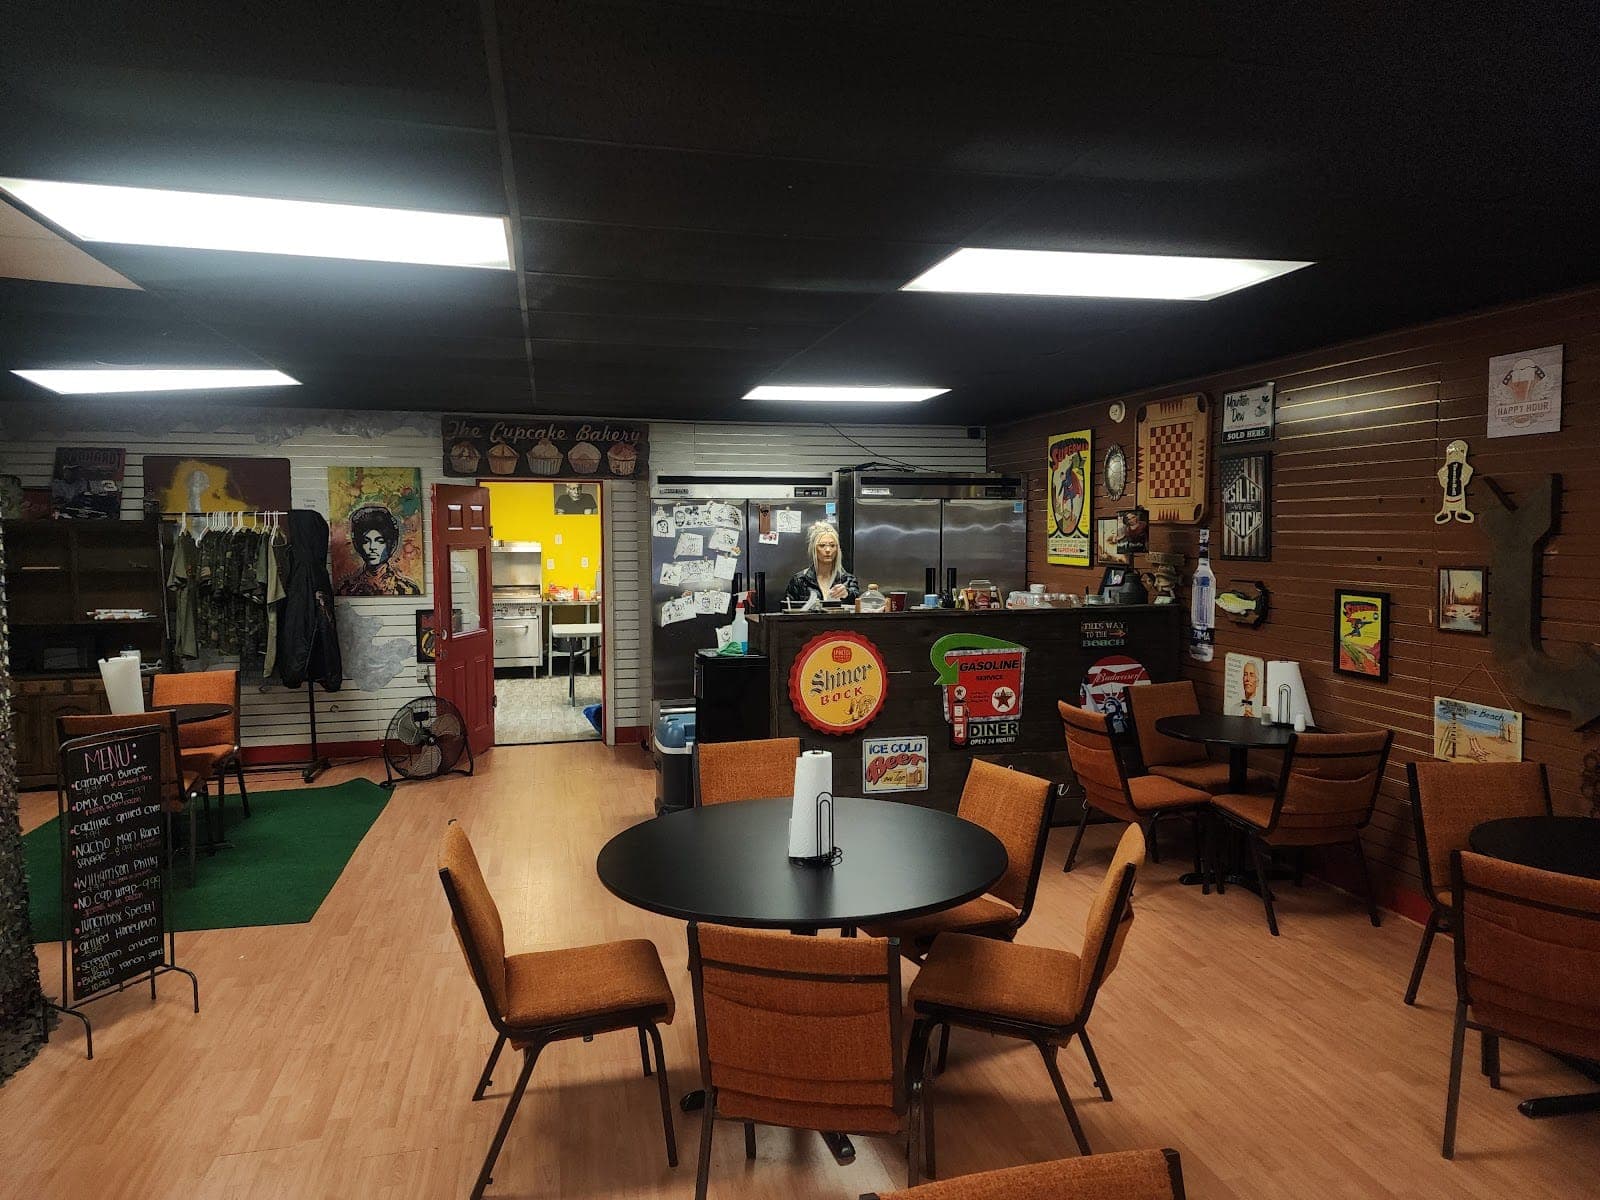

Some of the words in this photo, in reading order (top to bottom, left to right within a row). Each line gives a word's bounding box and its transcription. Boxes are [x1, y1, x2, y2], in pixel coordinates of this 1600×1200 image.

[1232, 407, 1244, 422] Dew
[1497, 406, 1523, 416] HAPPY
[1525, 401, 1549, 412] HOUR
[446, 420, 482, 440] The
[490, 421, 568, 444] Cupcake
[575, 424, 641, 446] Bakery
[1226, 431, 1245, 441] SOLD
[1247, 428, 1266, 438] HERE
[1083, 622, 1105, 630] THIS
[1193, 630, 1211, 641] ZIMA
[960, 660, 1019, 672] GASOLINE
[810, 664, 873, 697] Shiner
[1094, 671, 1142, 684] Budweiser
[820, 686, 863, 706] BOCK
[1478, 708, 1505, 722] Beach
[970, 723, 1018, 737] DINER
[869, 744, 888, 755] ICE
[891, 742, 922, 753] COLD
[970, 738, 987, 746] OPEN
[866, 753, 926, 786] Beer
[76, 797, 99, 813] DMX
